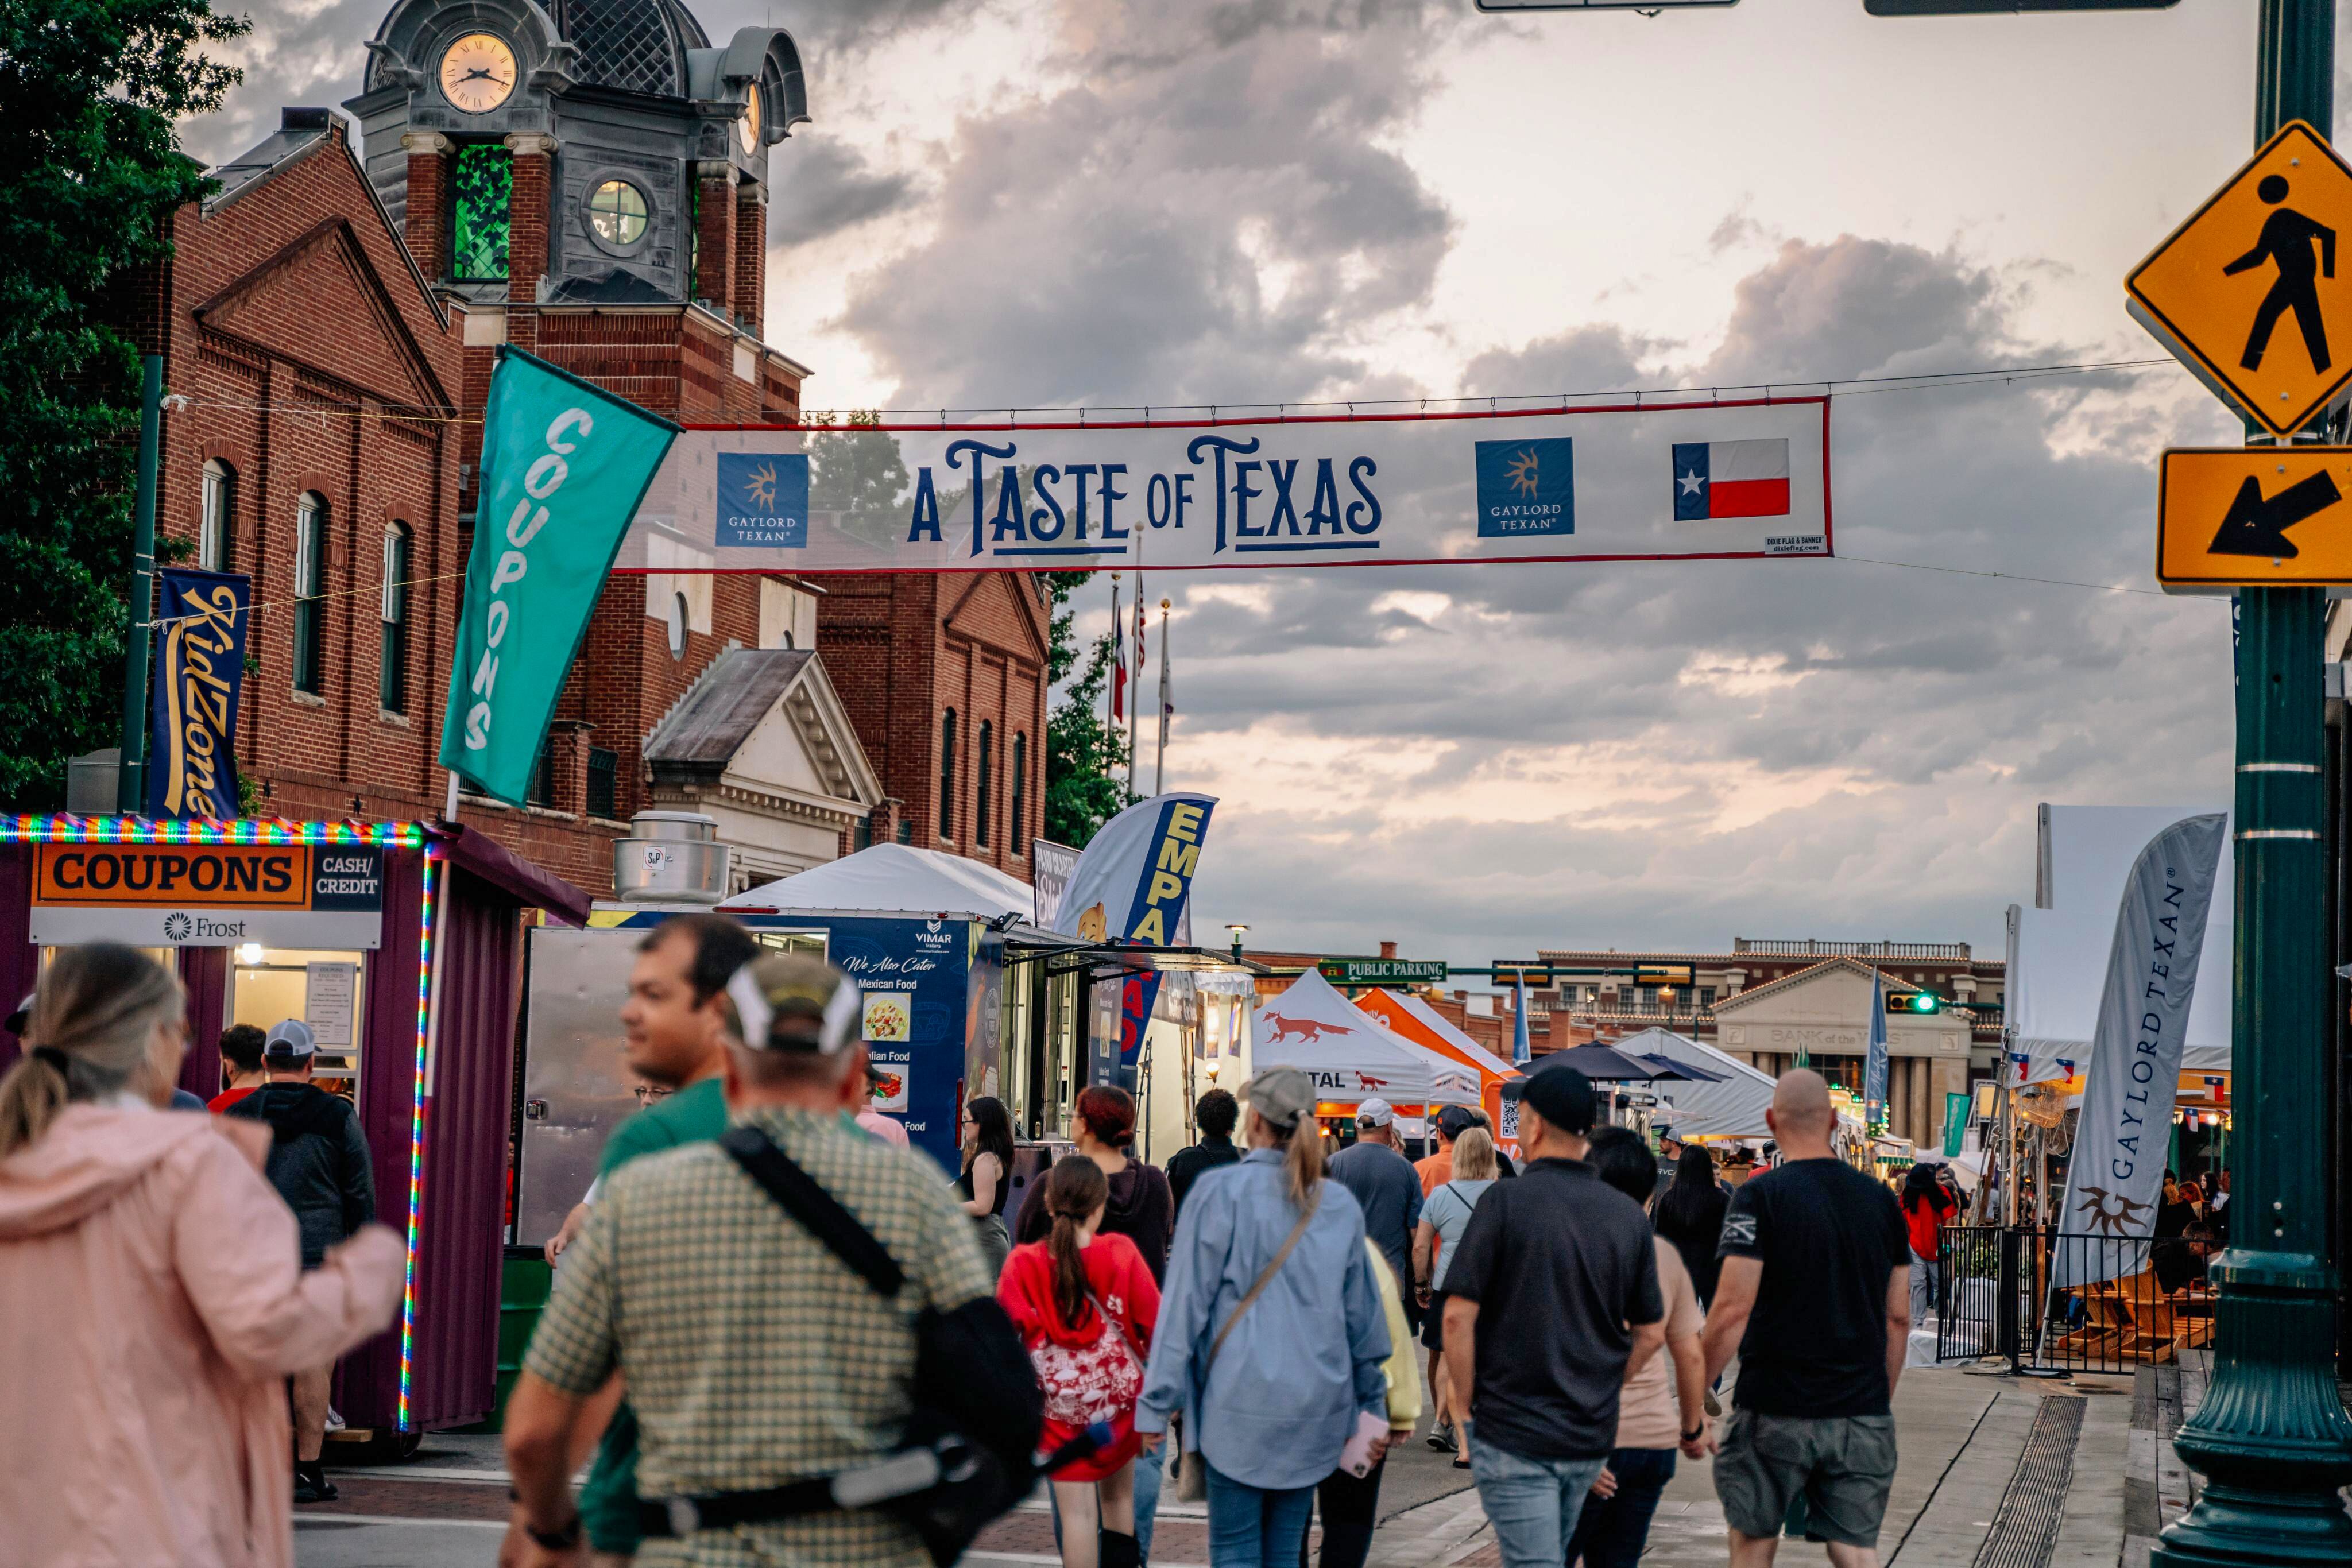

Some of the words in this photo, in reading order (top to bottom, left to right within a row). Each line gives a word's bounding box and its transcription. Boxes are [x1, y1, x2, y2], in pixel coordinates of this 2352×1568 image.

[906, 466, 943, 543] A
[945, 439, 1130, 559] TASTE
[1147, 473, 1195, 528] OF
[1187, 435, 1382, 555] TEXAS
[1491, 504, 1561, 516] GAYLORD
[729, 517, 795, 527] GAYLORD
[465, 407, 594, 751] COUPONS
[180, 586, 237, 819] KidZone
[322, 857, 373, 876] CASH/
[648, 852, 660, 864] S&P
[1051, 851, 1074, 878] CRAFTE
[53, 853, 292, 892] COUPONS
[316, 878, 378, 895] CREDIT
[195, 917, 246, 938] Frost
[915, 933, 951, 943] VIMAR
[842, 955, 869, 973] We
[868, 956, 901, 973] Also
[900, 957, 938, 973] Cater
[1348, 963, 1390, 976] PUBLIC
[1393, 963, 1444, 976] PARKING
[858, 978, 894, 989] Mexican
[896, 979, 917, 989] Food
[1771, 1029, 1823, 1043] BANK
[1825, 1035, 1836, 1044] of
[1838, 1034, 1856, 1044] the
[889, 1051, 910, 1062] Food
[2112, 1011, 2161, 1180] GAYLORD
[904, 1121, 926, 1132] Food
